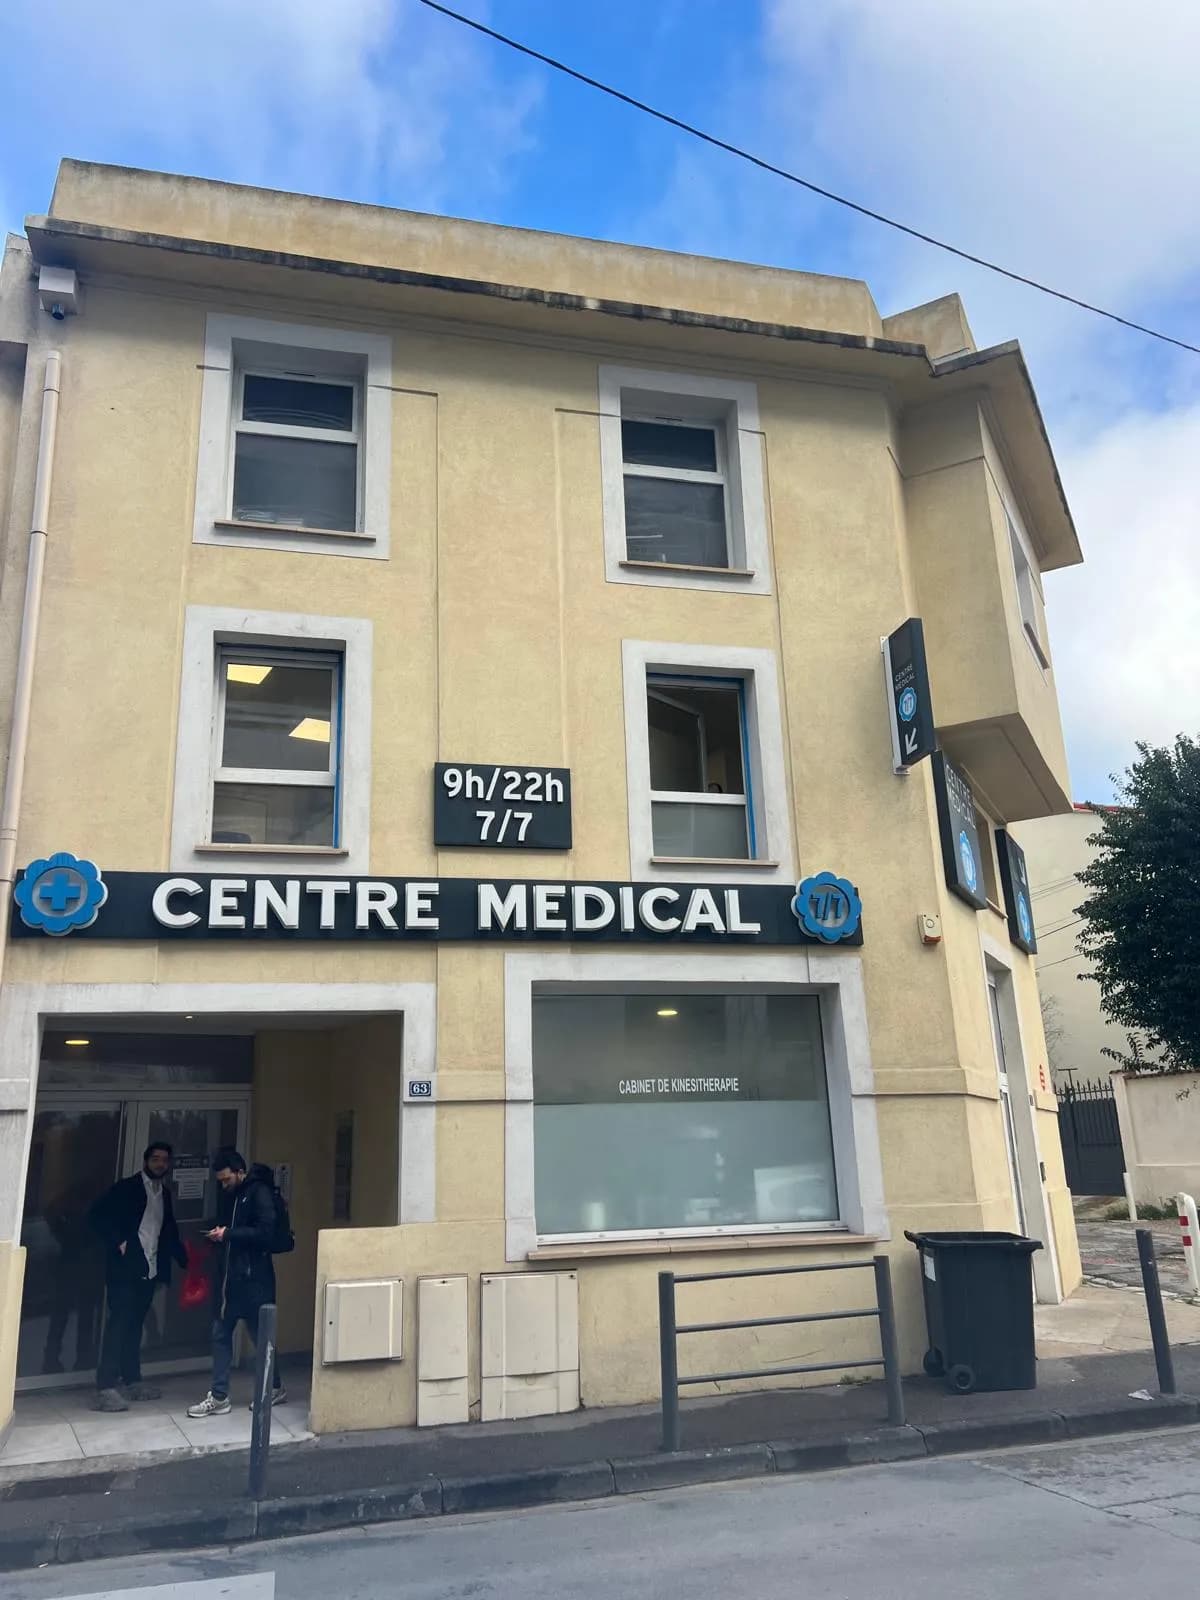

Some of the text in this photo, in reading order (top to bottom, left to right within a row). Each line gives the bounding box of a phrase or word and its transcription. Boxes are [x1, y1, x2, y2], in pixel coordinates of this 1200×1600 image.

[443, 767, 564, 803] 9h/22h
[475, 808, 533, 843] 7/7
[152, 878, 762, 935] CENTRE MEDICAL
[412, 1083, 428, 1094] 63
[619, 1077, 739, 1094] CABINET DE KINESITHERAPIE
